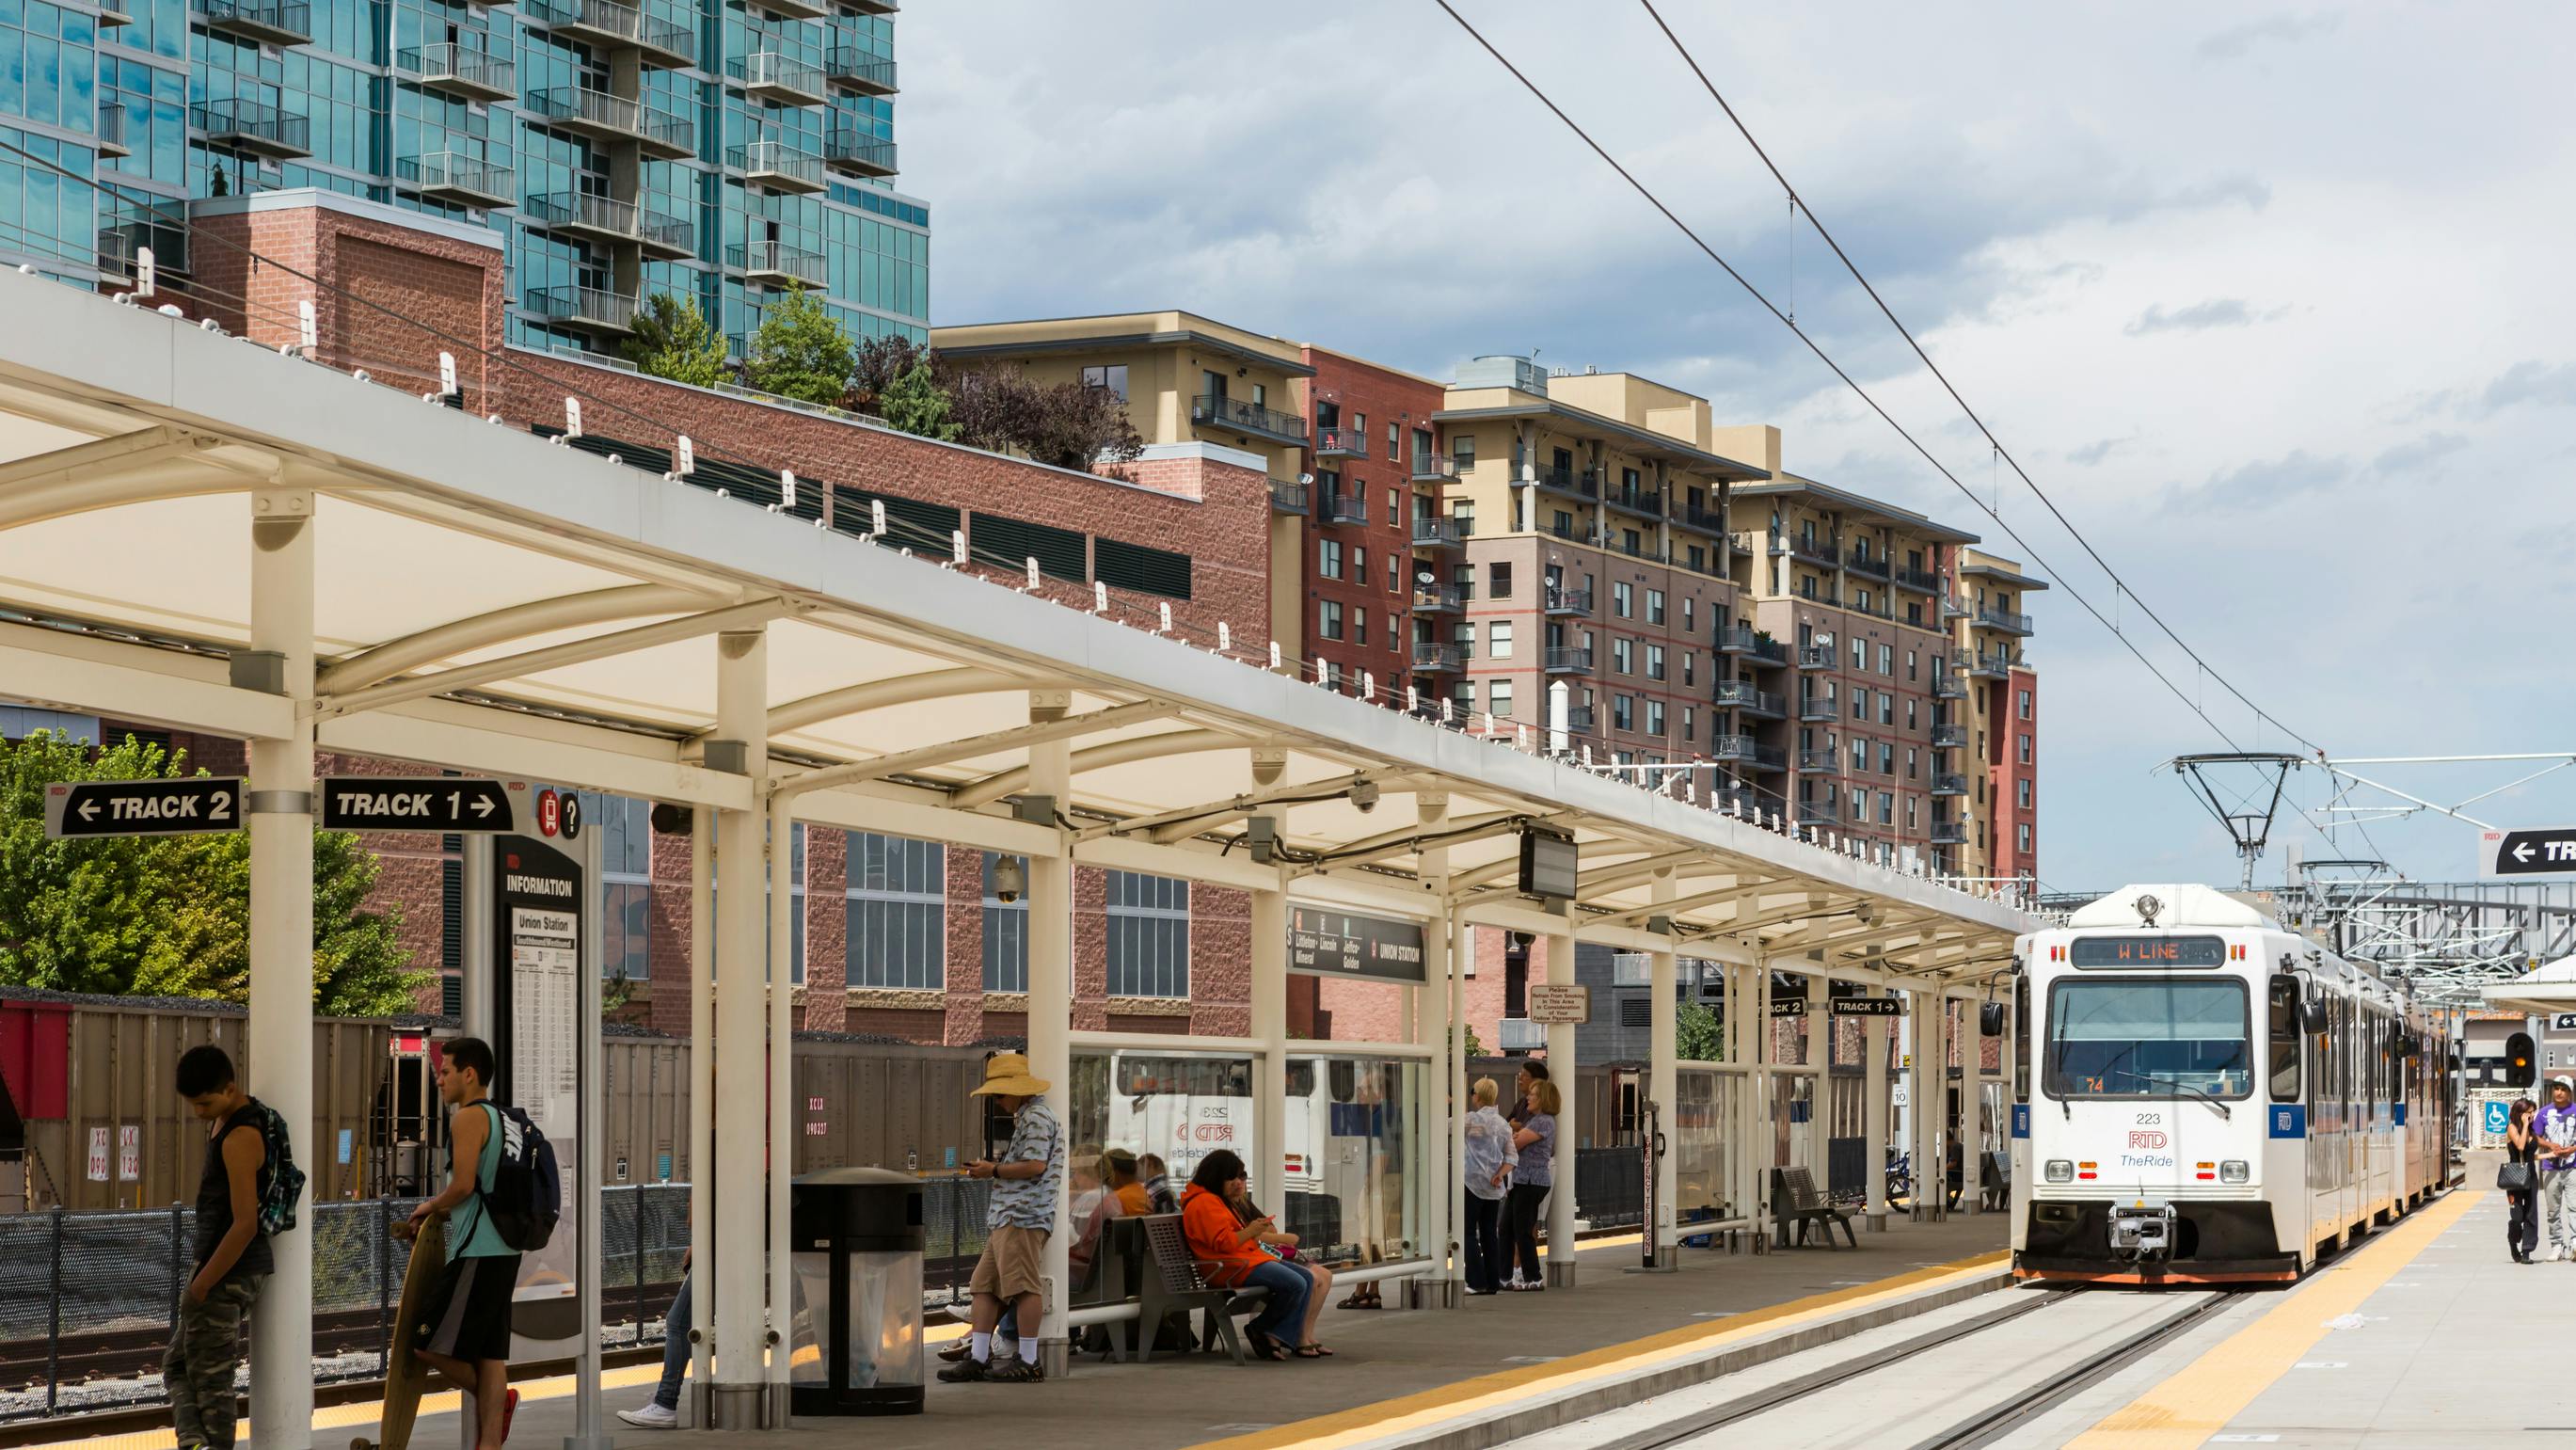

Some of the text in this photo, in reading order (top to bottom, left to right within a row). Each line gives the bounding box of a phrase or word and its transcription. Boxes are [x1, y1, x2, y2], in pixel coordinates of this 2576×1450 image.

[109, 790, 231, 820] TRACK 2
[336, 790, 461, 820] TRACK 1
[507, 874, 572, 897] INFORMATION
[519, 914, 568, 932] Union Station
[1319, 936, 1337, 951] Lincoln
[1296, 949, 1314, 964] Mineral
[1380, 943, 1420, 964] UNION STATION
[2119, 943, 2180, 960] W LINE
[1344, 955, 1360, 969] Golden
[1792, 1002, 1801, 1012] 2
[1837, 1001, 1883, 1012] TRACK 1
[2086, 1077, 2104, 1093] 74
[809, 1097, 823, 1111] XCLX
[1894, 1092, 1906, 1102] 10
[2136, 1113, 2161, 1124] 223
[805, 1122, 827, 1136] 090327
[95, 1129, 105, 1147] XC
[2128, 1130, 2168, 1150] RTD
[2120, 1154, 2173, 1168] TheRide
